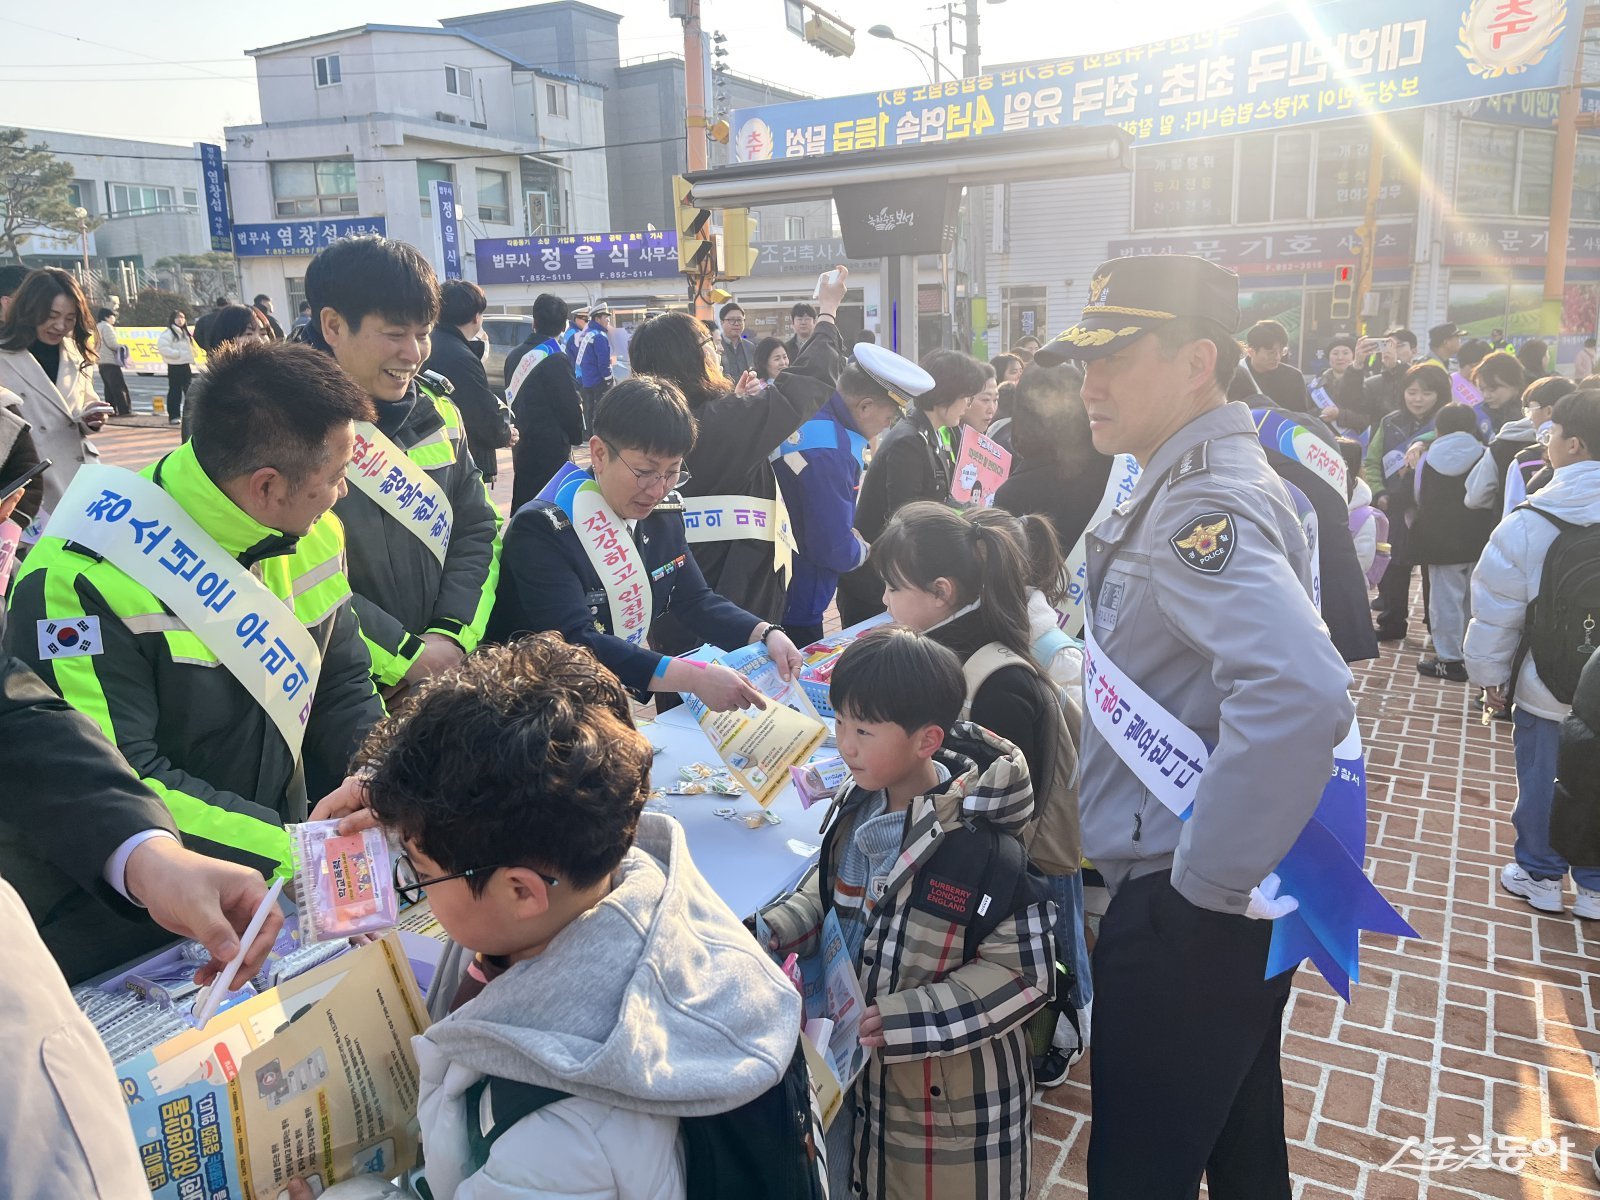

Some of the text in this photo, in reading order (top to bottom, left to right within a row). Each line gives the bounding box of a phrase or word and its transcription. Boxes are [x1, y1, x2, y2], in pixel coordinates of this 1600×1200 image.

[438, 186, 453, 196] 법무사
[895, 208, 914, 227] 보성
[237, 231, 271, 246] 법무사
[277, 224, 338, 247] 염창섭
[442, 201, 457, 267] 정을식
[1337, 234, 1397, 248] 사소
[492, 243, 679, 271] 법무사 정을식 사무소
[520, 274, 572, 283] T.852-5115
[600, 271, 653, 280] F.852-5114
[376, 466, 440, 520] 행복한
[733, 508, 767, 528] 미래
[1199, 547, 1226, 565] POLICE
[582, 510, 638, 586] 건강하고
[618, 583, 646, 630] 안전한
[83, 489, 237, 616] 청소년은
[233, 611, 311, 701] 우리의
[1097, 675, 1131, 724] 사랑이
[1123, 712, 1204, 789] 필요합니다
[929, 878, 972, 899] BURBERRY
[931, 887, 966, 905] LONDON
[926, 894, 966, 913] ENGLAND
[325, 1007, 337, 1032] 신고하기
[199, 1094, 215, 1124] 입니다.
[161, 1097, 197, 1179] 허위영상물
[201, 1125, 220, 1155] 중범죄
